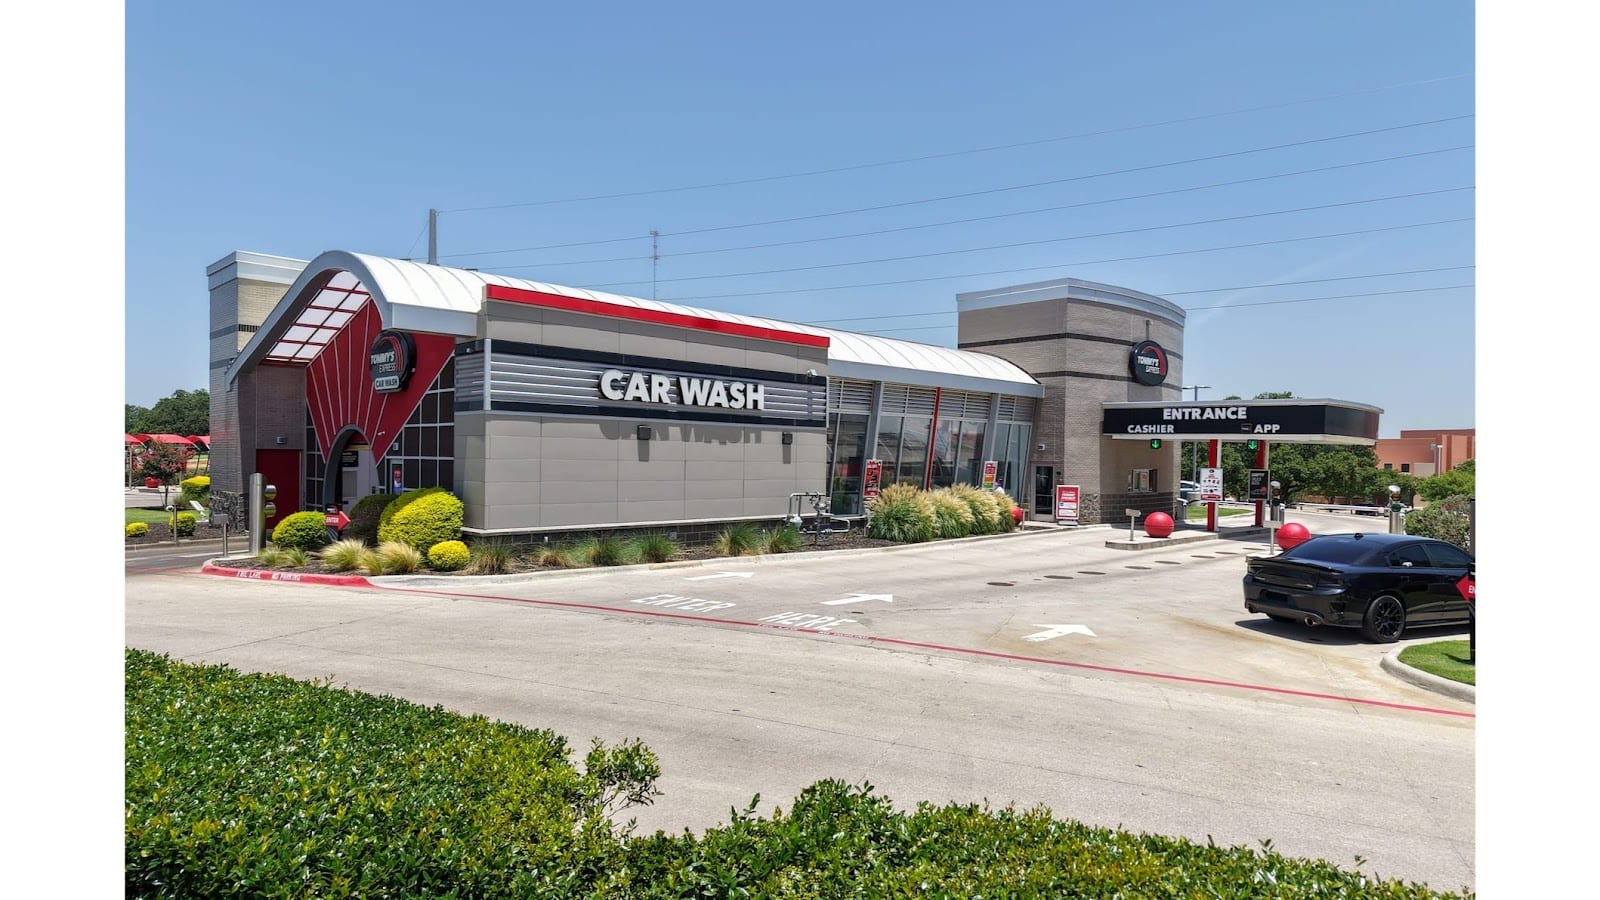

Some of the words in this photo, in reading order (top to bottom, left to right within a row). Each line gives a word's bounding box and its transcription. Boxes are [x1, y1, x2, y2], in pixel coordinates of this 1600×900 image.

[600, 369, 671, 404] CAR
[679, 377, 765, 410] WASH
[1163, 406, 1247, 420] ENTRANCE
[1127, 424, 1175, 433] CASHIER
[1254, 424, 1280, 433] APP
[630, 594, 736, 613] ENTER
[757, 611, 857, 631] HERE
